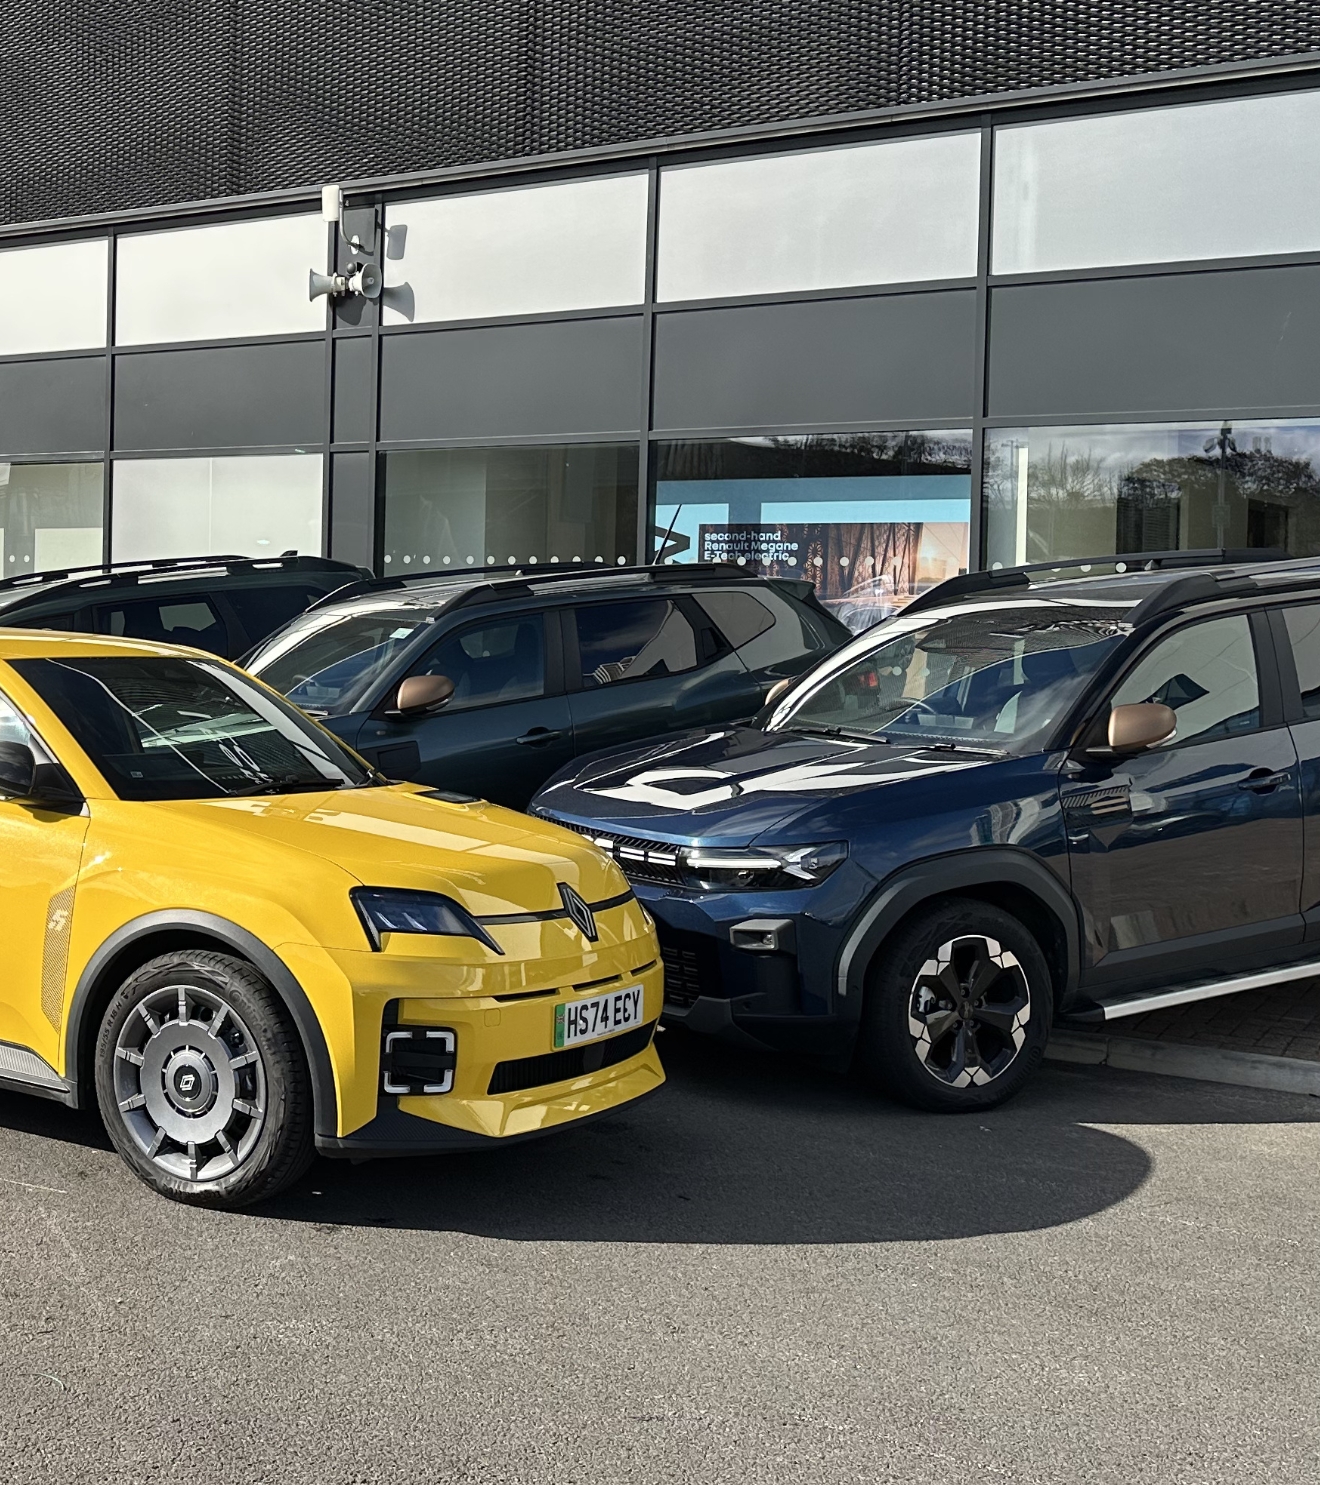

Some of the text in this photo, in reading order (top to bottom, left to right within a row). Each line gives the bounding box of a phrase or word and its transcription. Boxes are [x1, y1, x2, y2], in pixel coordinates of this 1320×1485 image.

[704, 531, 781, 541] second-hand
[704, 541, 798, 553] Renault Megane
[704, 551, 790, 560] E-Tech electric
[567, 989, 640, 1038] HS74 ECY
